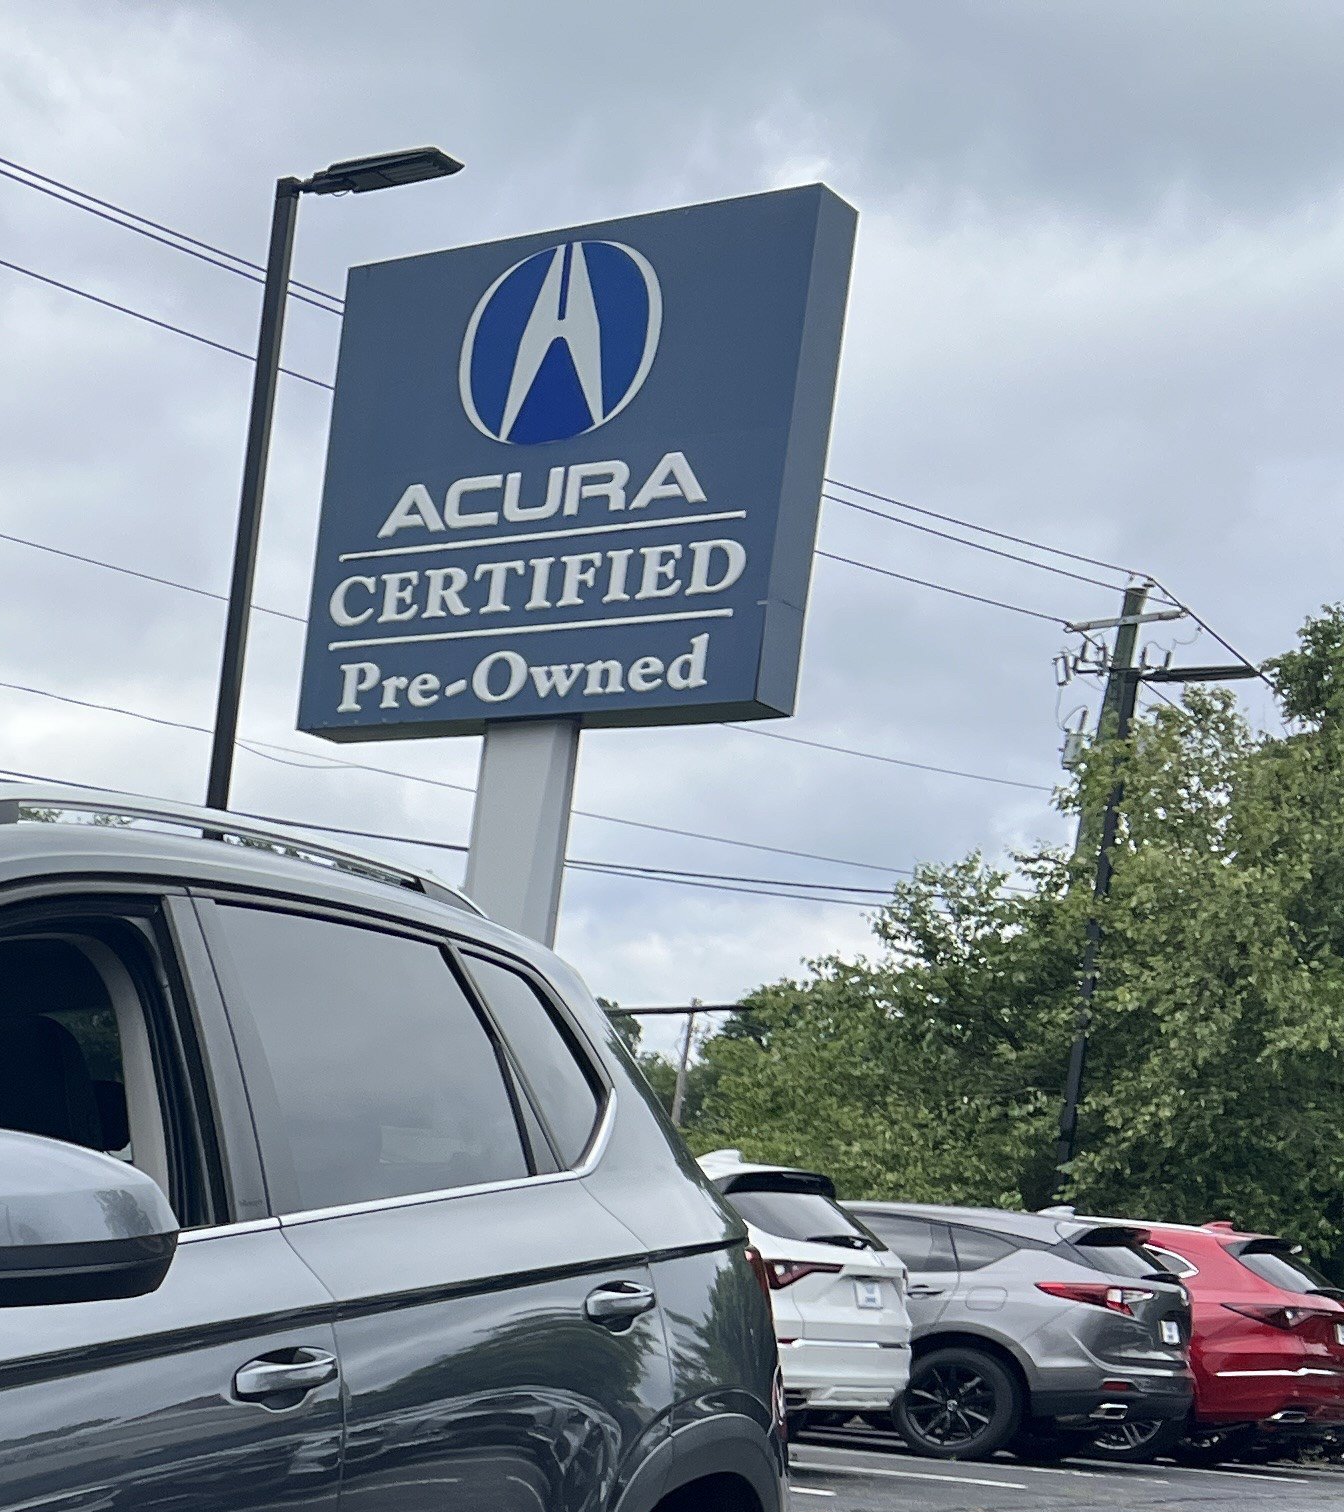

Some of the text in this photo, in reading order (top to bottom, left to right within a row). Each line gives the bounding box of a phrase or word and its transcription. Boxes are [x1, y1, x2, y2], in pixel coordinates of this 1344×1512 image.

[376, 451, 708, 538] ACURA
[329, 538, 747, 627] CERTIFIED
[336, 632, 710, 713] Pre-Owned
